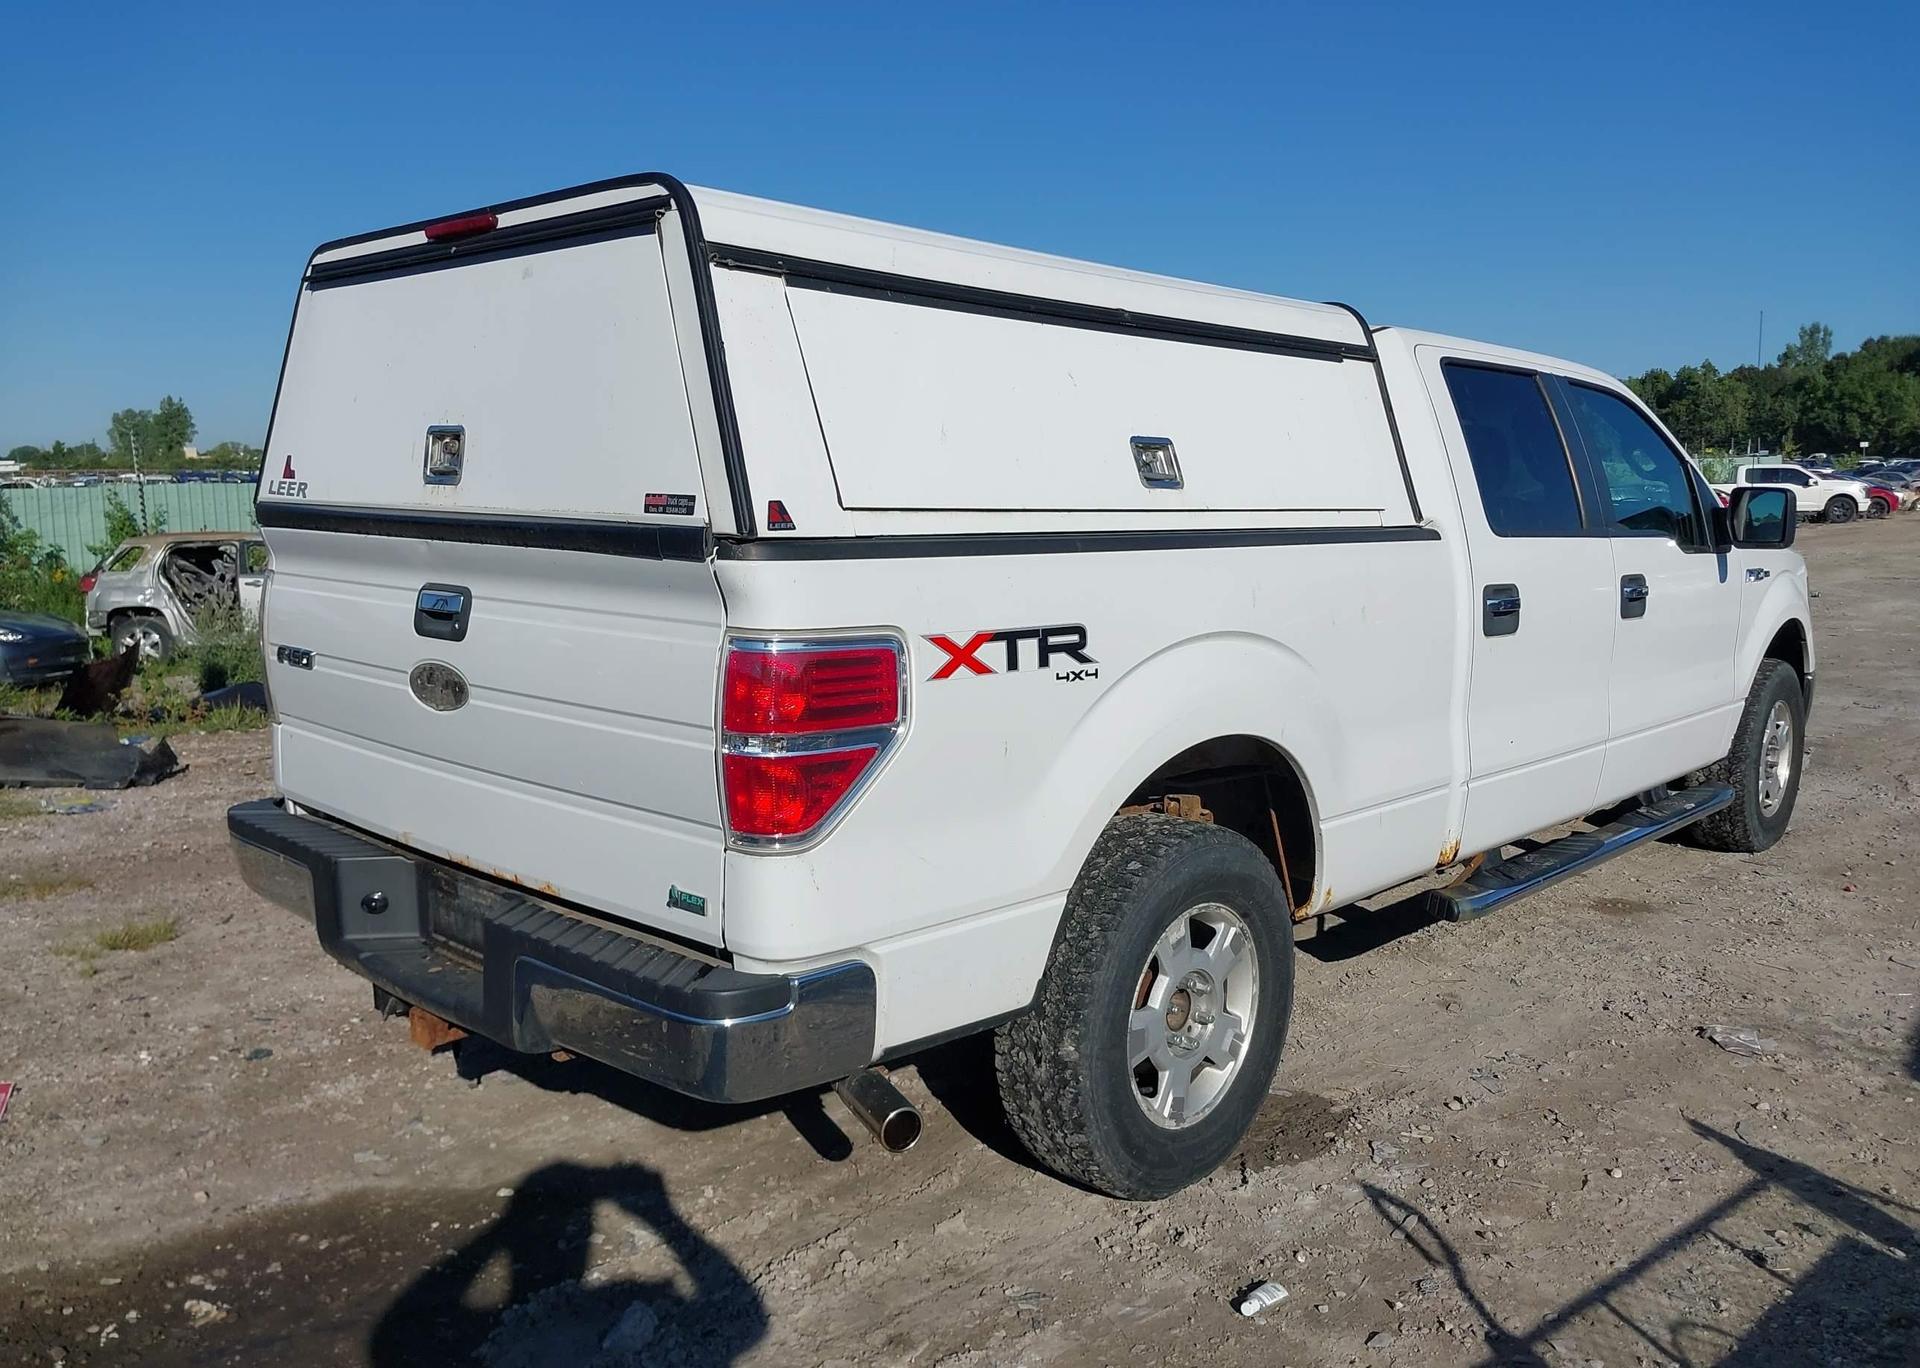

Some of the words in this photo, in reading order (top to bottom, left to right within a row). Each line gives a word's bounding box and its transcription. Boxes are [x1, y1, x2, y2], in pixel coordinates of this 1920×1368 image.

[268, 480, 308, 498] LEER
[920, 623, 1099, 682] XTR
[681, 893, 704, 907] FLEX
